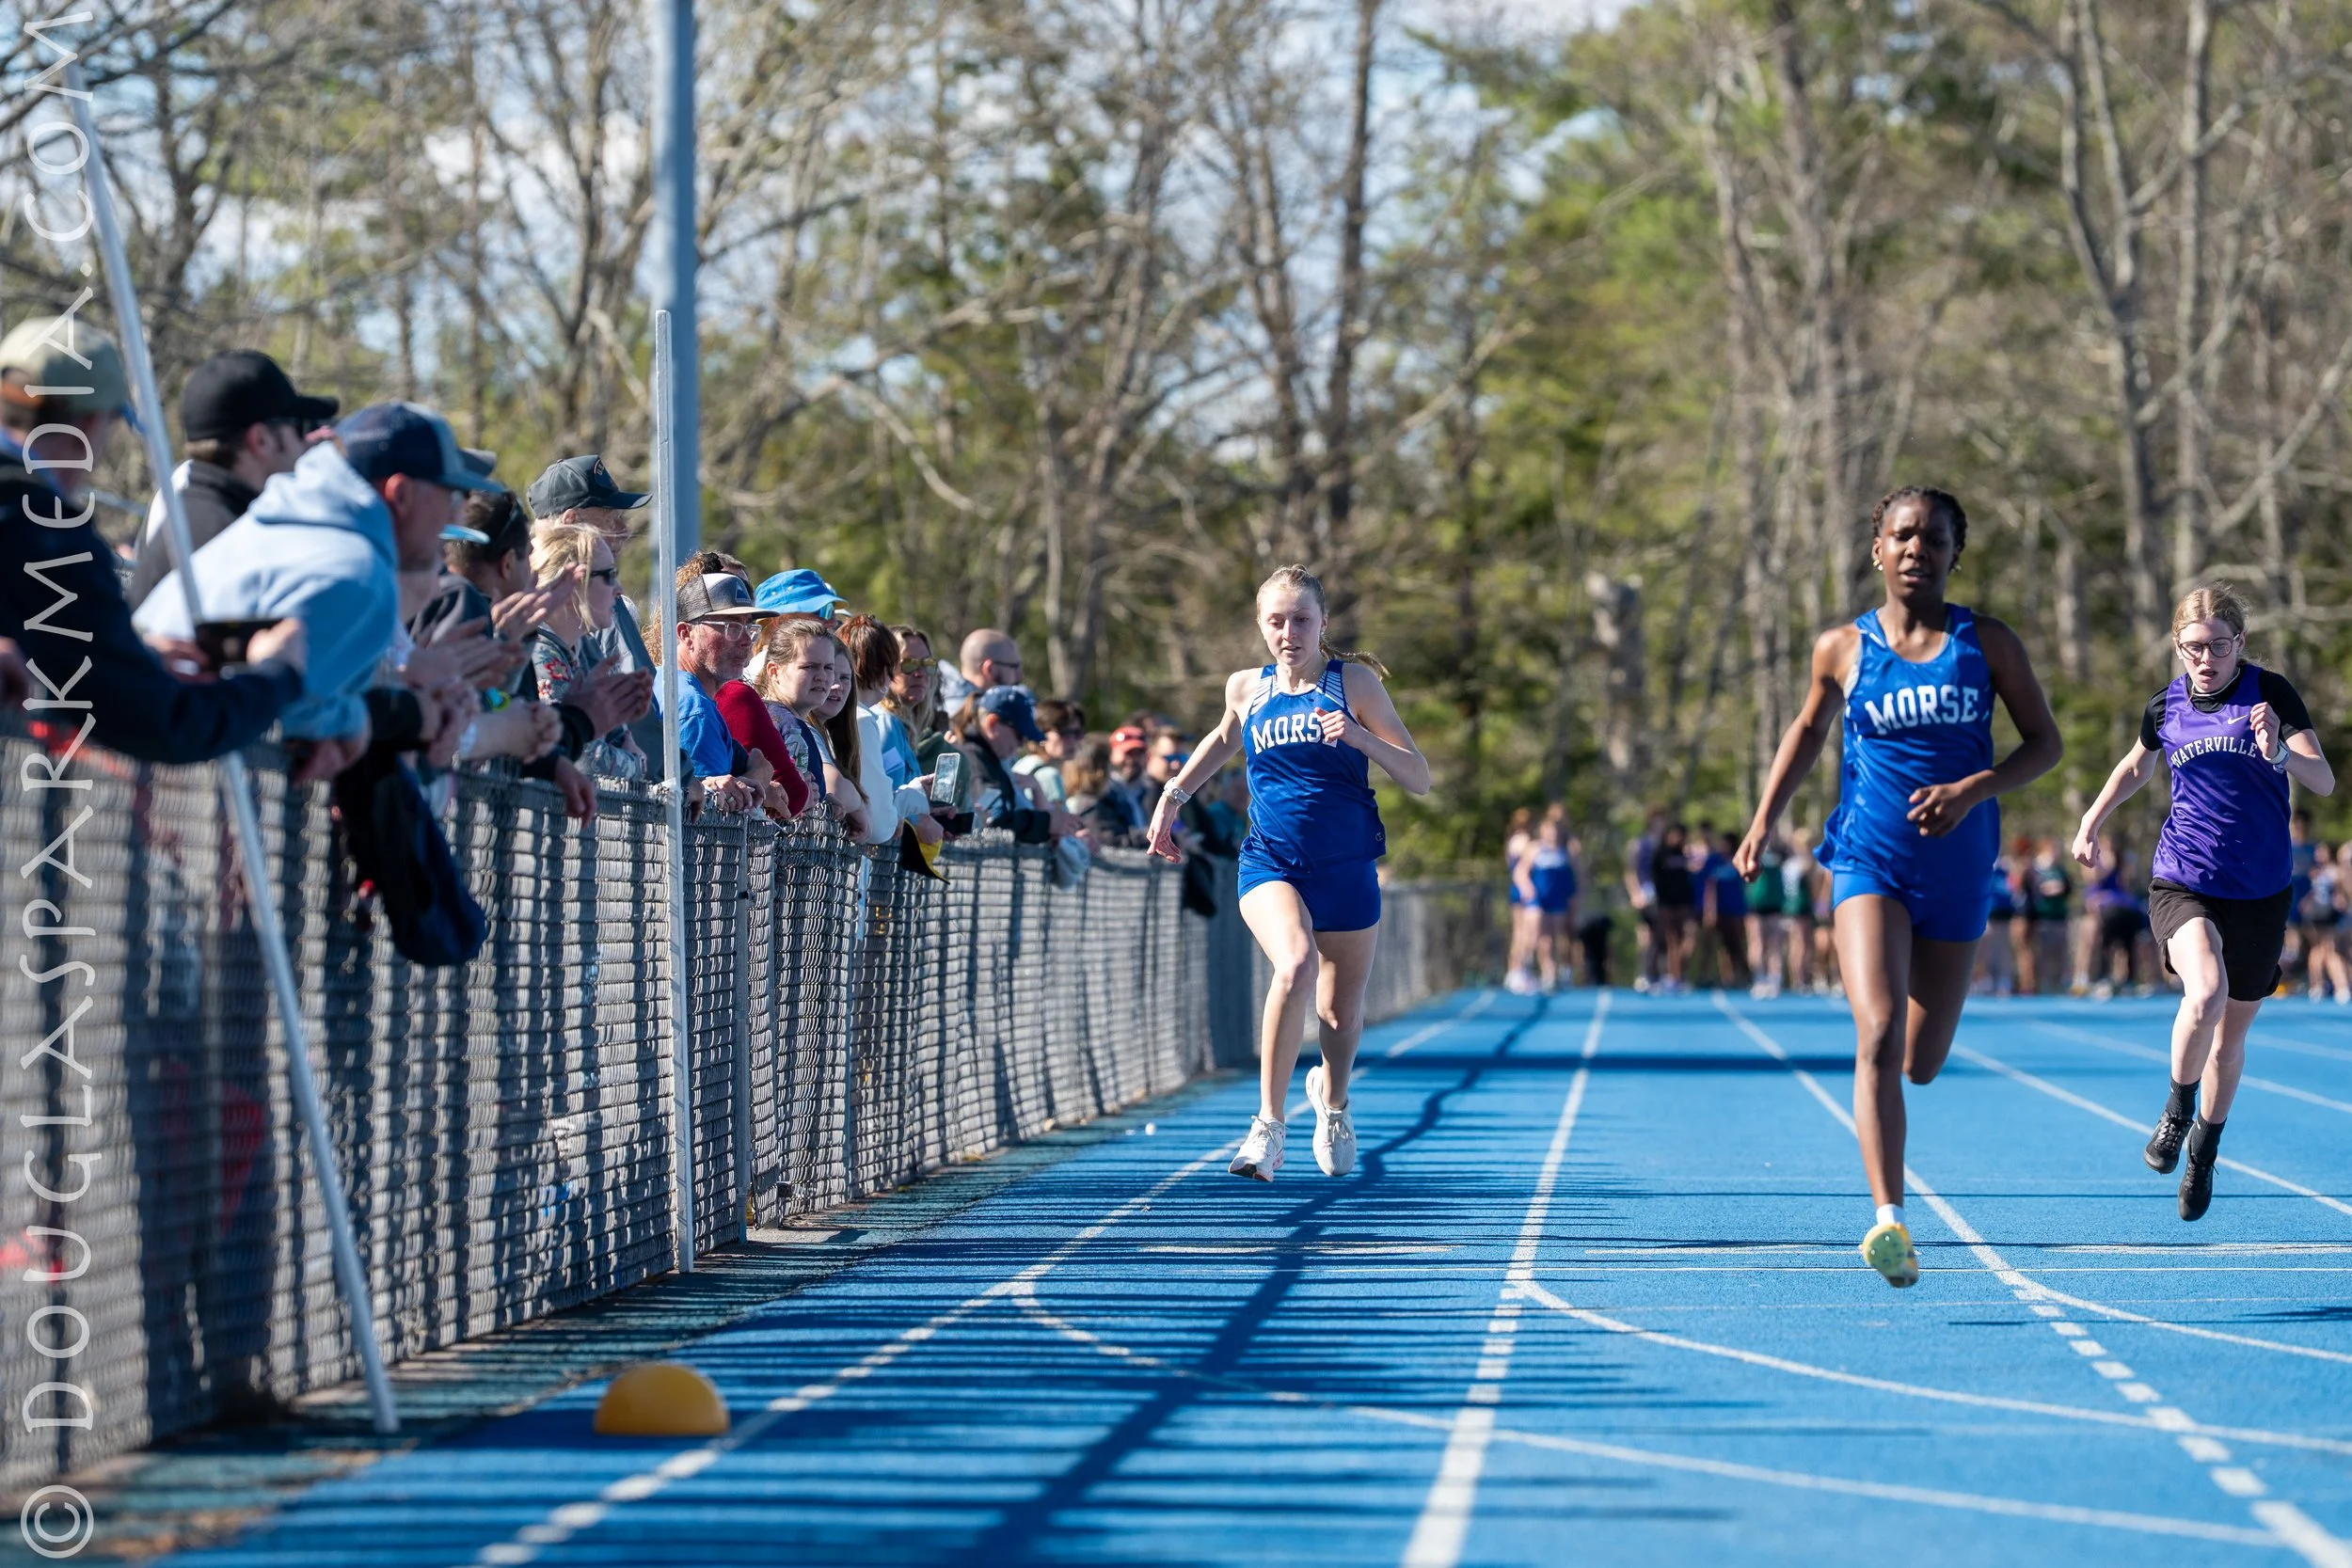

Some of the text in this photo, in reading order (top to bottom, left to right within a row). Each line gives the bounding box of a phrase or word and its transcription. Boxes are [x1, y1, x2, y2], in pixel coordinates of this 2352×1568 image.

[1864, 684, 1979, 736] MORSE
[1250, 713, 1338, 755] MORS
[2170, 736, 2259, 768] WATERVILLE
